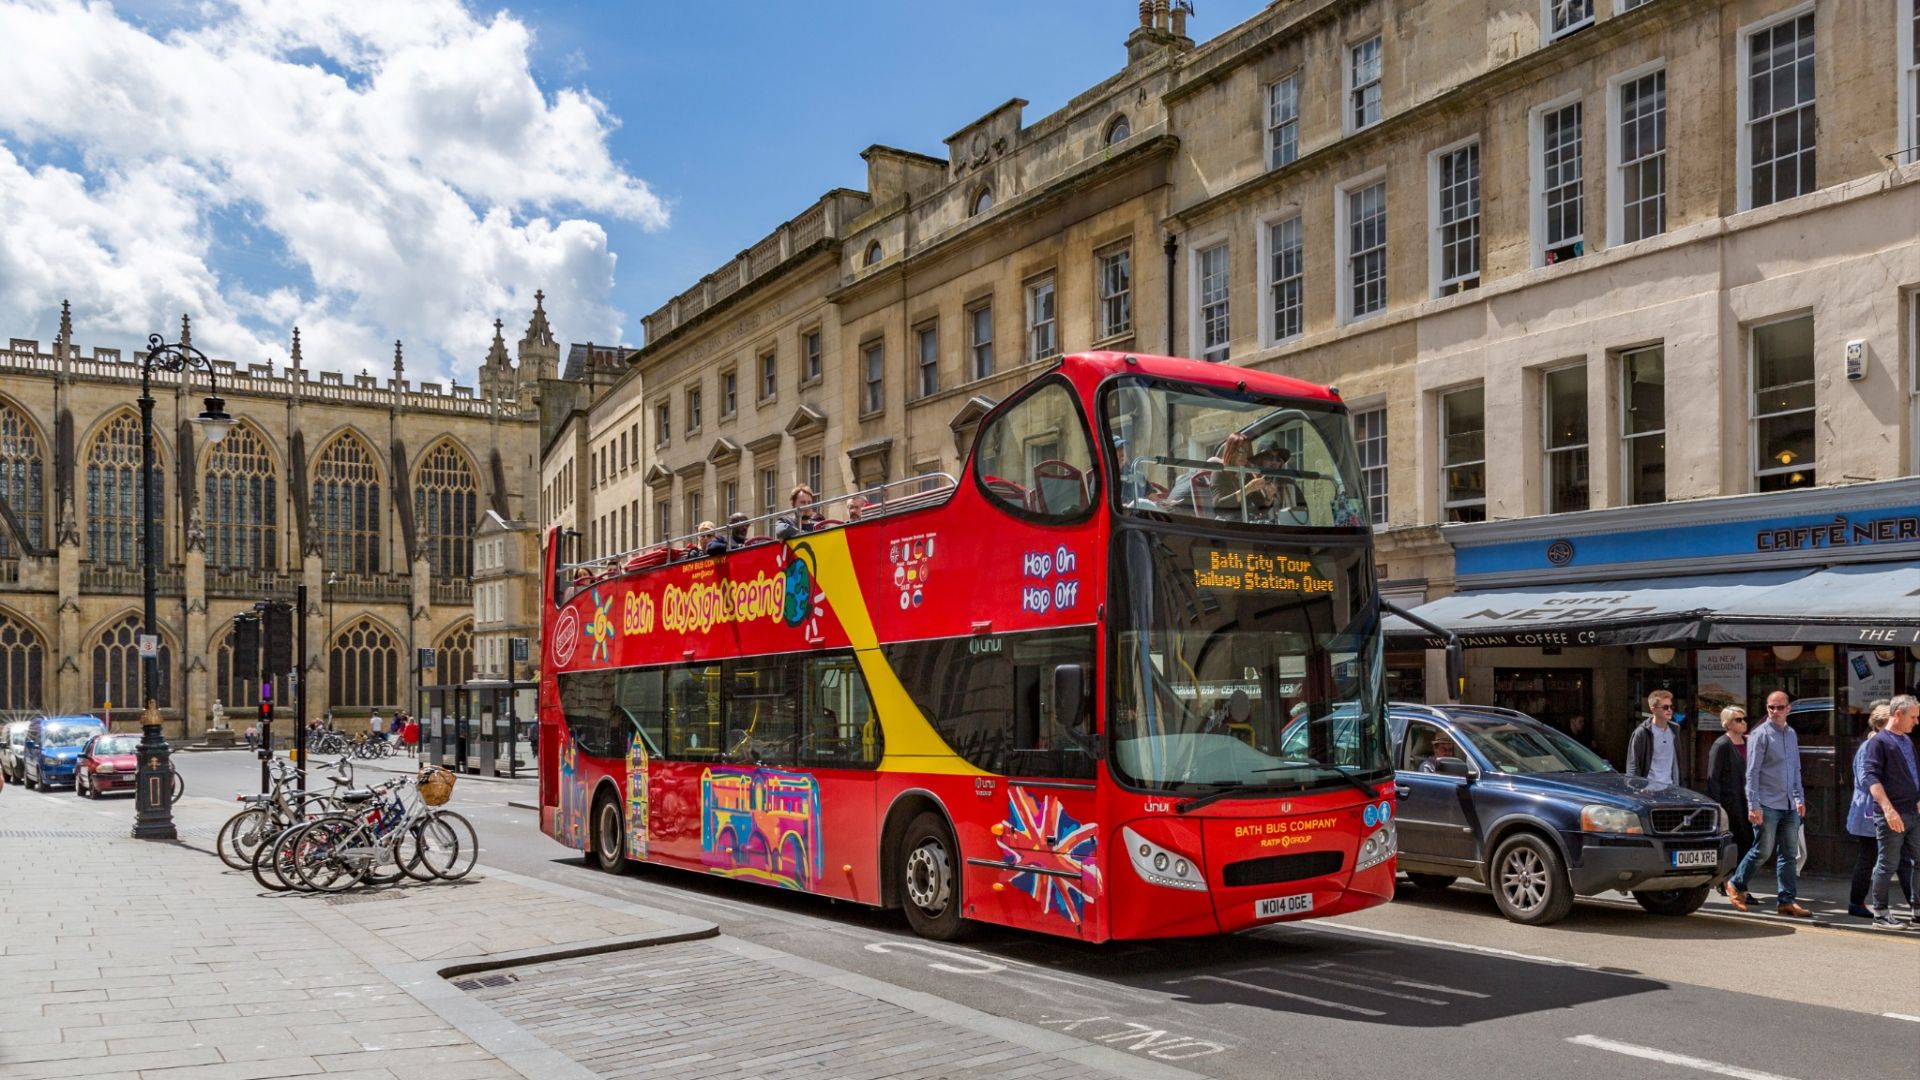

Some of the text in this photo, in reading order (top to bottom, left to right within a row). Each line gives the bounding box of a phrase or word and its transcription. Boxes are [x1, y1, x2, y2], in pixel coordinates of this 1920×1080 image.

[1024, 545, 1076, 578] Hop On
[1210, 551, 1312, 573] Bath City Tour
[624, 569, 787, 636] Bath CitySightseeing
[1023, 581, 1078, 614] Hop Off
[1461, 635, 1507, 647] TALIAN
[1515, 632, 1568, 645] COFFEE
[1858, 629, 1898, 641] THE
[1235, 818, 1337, 837] BATH BUS COMPANY
[1261, 835, 1312, 847] RATP GROUP
[1678, 851, 1716, 864] OU04 XRG
[1262, 895, 1308, 914] WO14 OGE
[1037, 1015, 1225, 1060] ONLY
